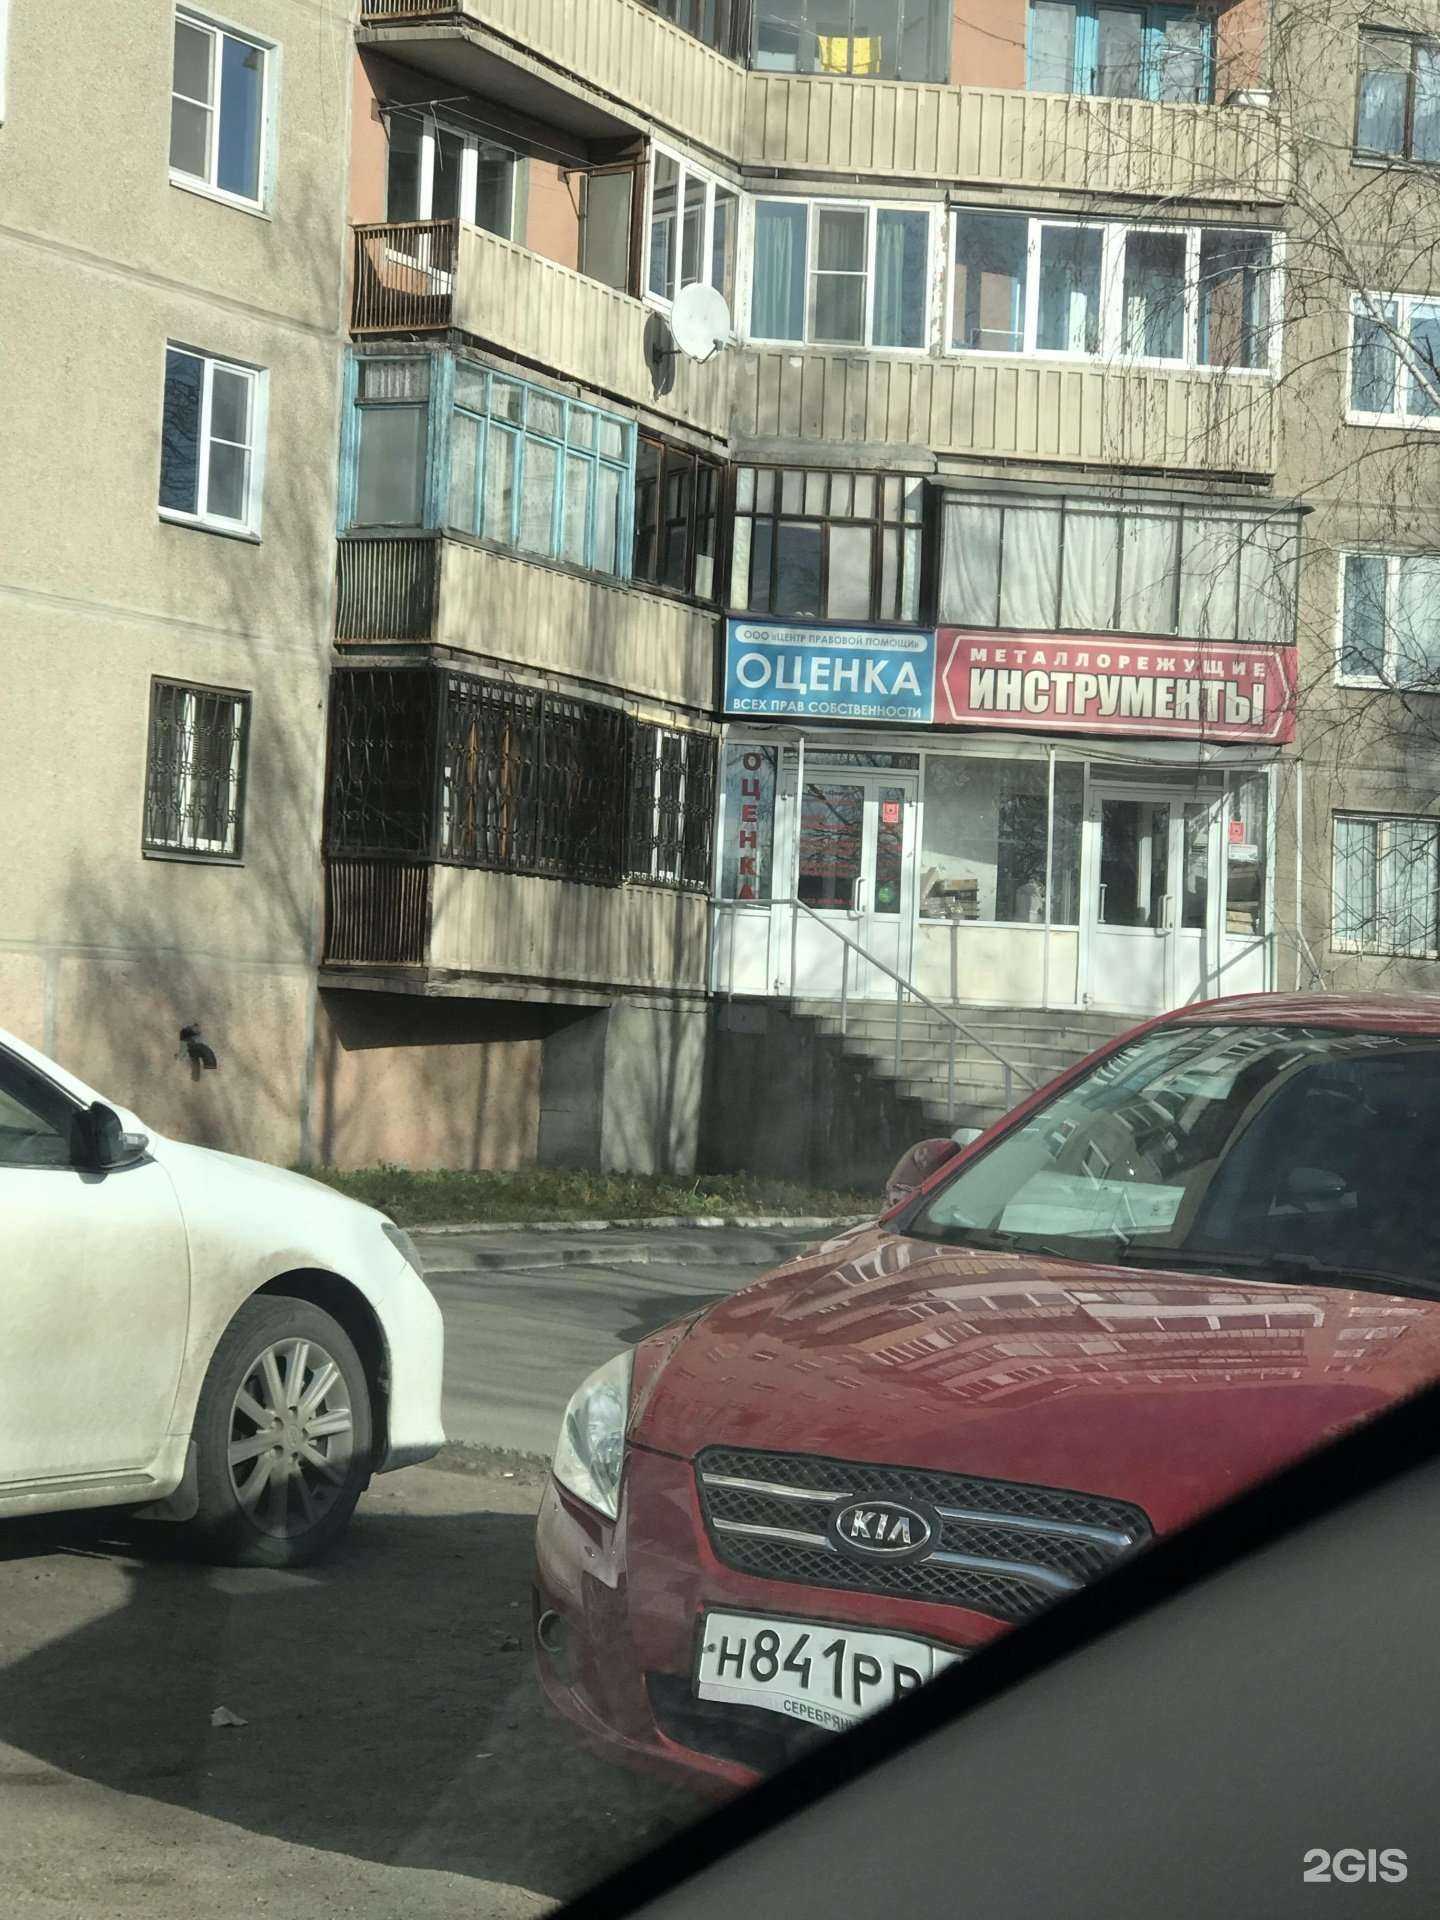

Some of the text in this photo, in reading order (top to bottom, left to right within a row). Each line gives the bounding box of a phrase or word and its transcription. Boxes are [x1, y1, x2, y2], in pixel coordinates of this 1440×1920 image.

[743, 630, 770, 641] ООО
[808, 634, 863, 647] ПРАВОВОЙ
[865, 637, 919, 649] ПОМОЩИ»
[736, 652, 922, 696] ОЦЕНКА
[970, 647, 1267, 678] МЕТАЛЛОРЕЖУЩИЕ
[733, 698, 921, 718] ВСЕХ ПРАВ СОБСТВЕННОСТИ
[968, 667, 1266, 726] ИНСТРУМЕНТЫ
[739, 752, 763, 899] ОЦЕНКА
[851, 1509, 912, 1544] KIA
